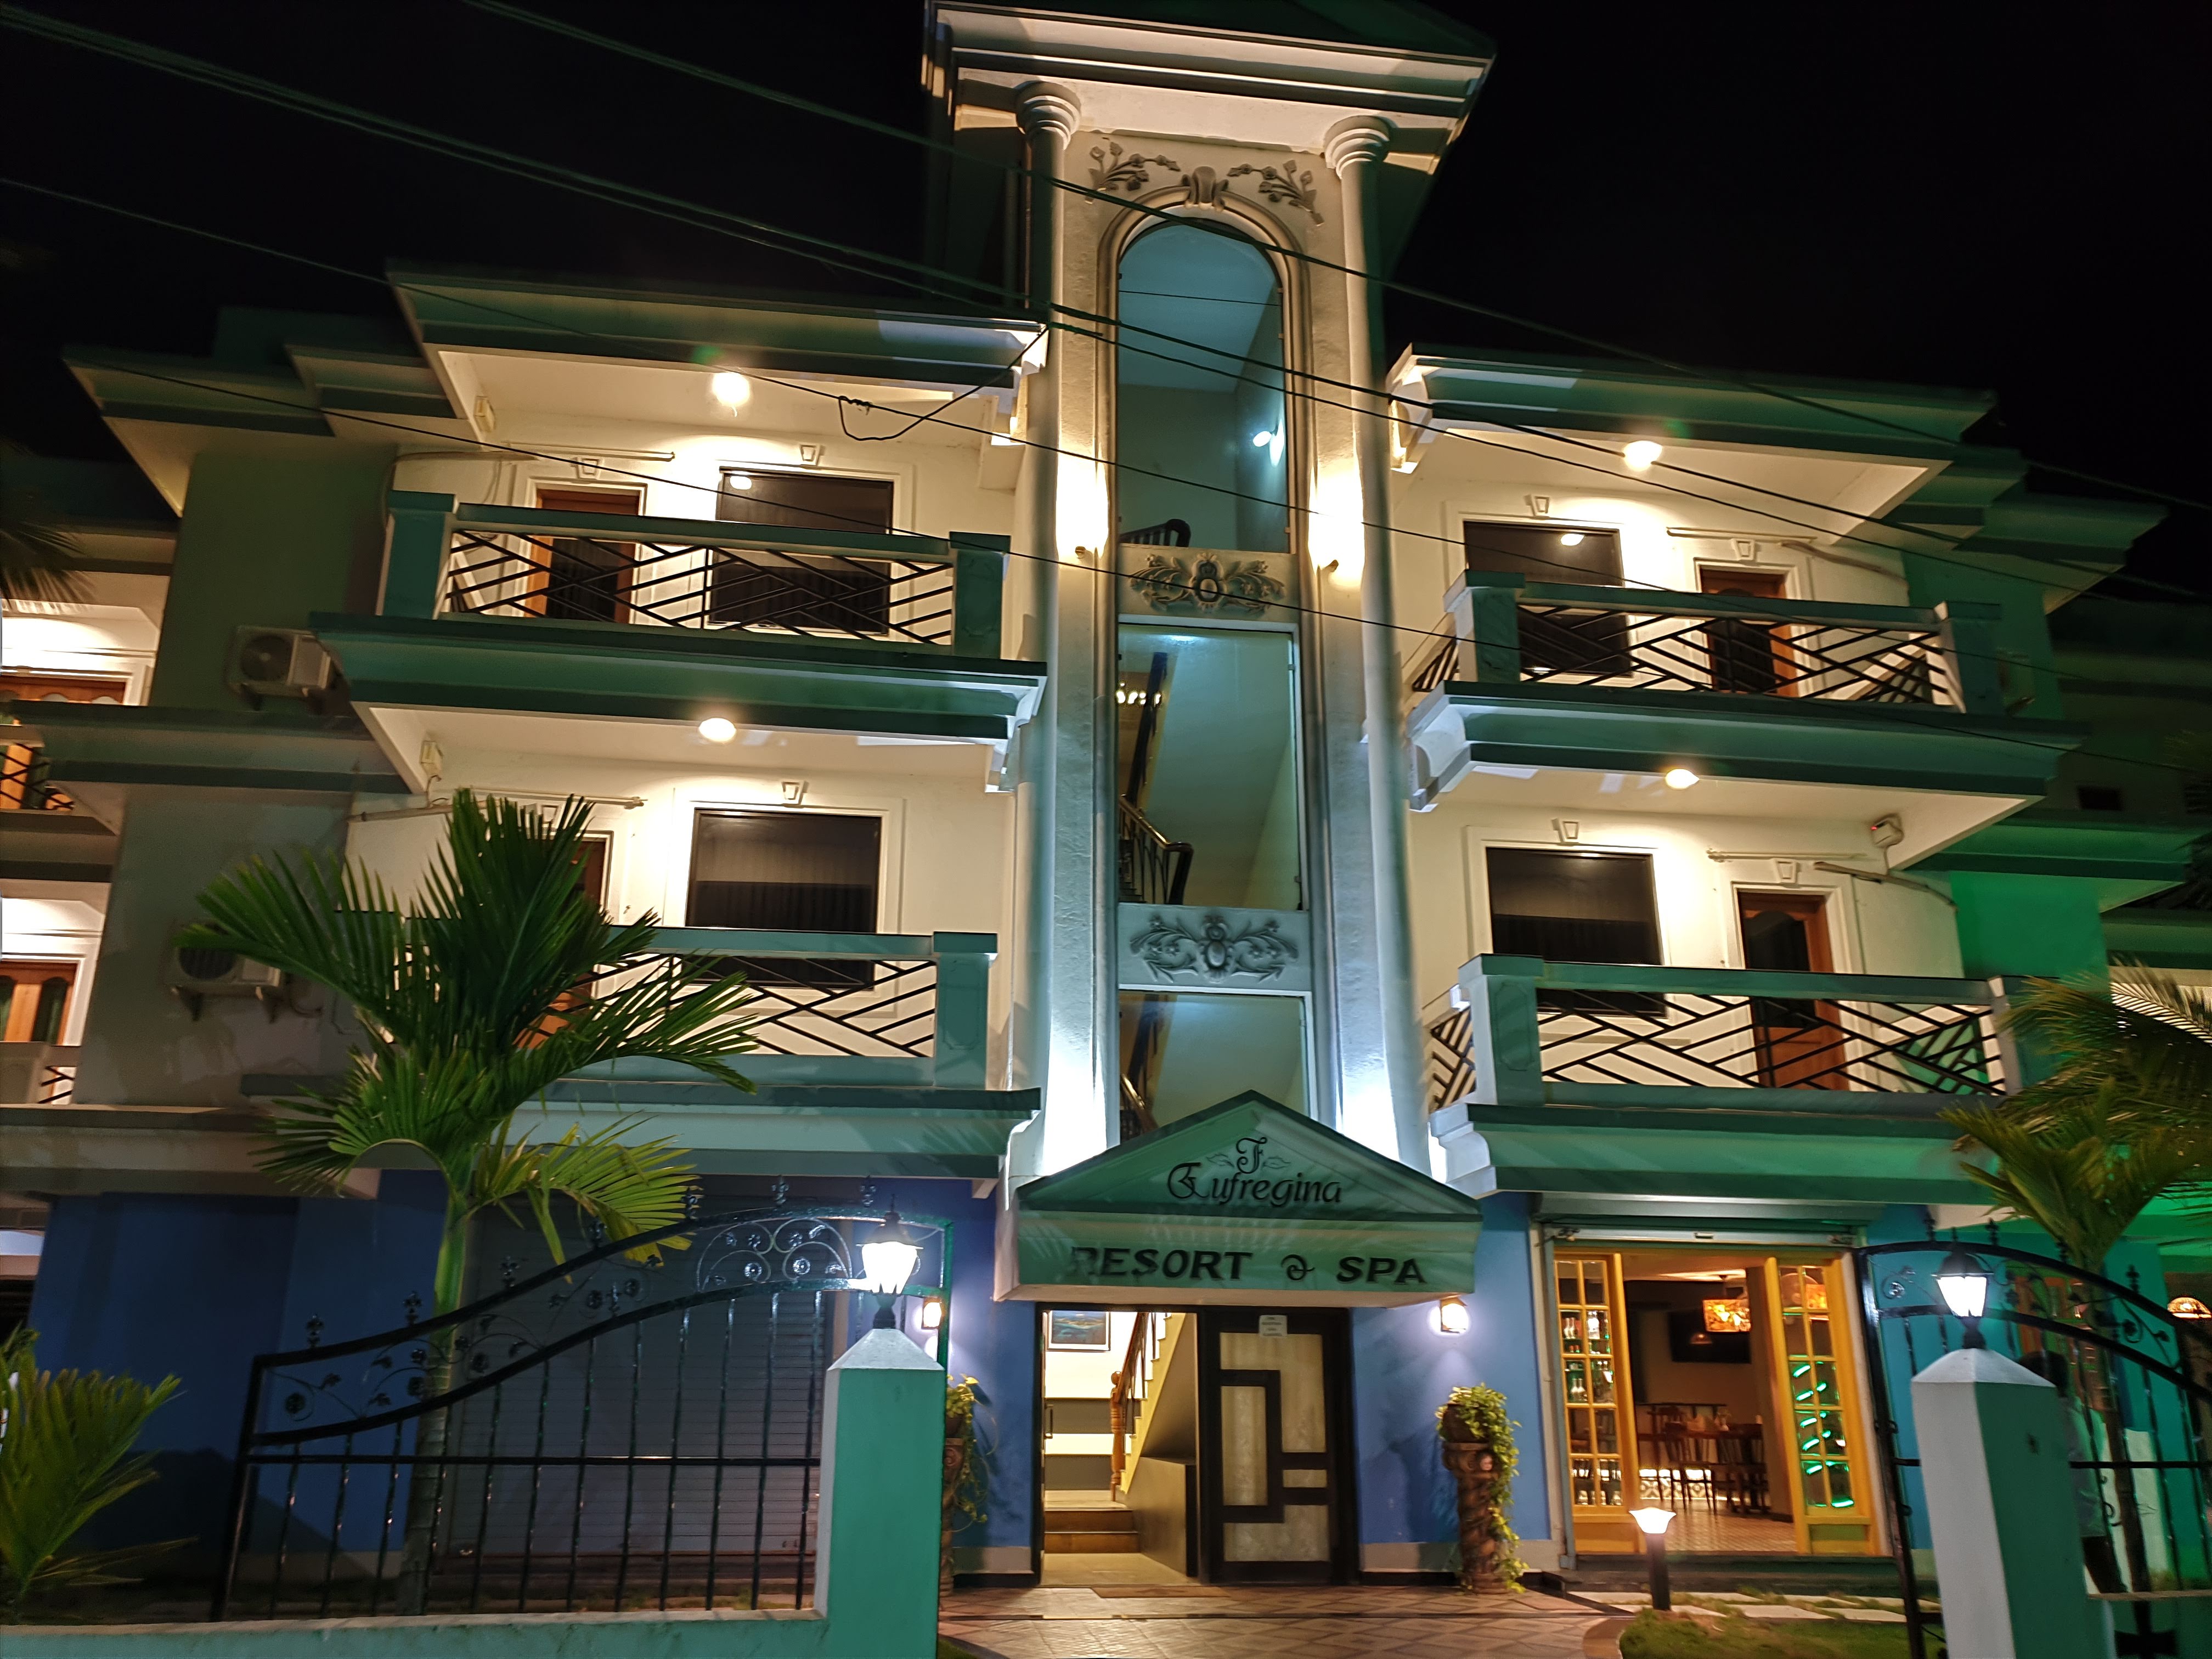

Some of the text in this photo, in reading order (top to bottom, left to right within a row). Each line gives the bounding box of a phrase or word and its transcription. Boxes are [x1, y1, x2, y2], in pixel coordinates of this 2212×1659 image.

[1167, 1161, 1342, 1207] Eufregina
[1068, 1246, 1254, 1280] RESORT
[1336, 1256, 1427, 1285] SPA
